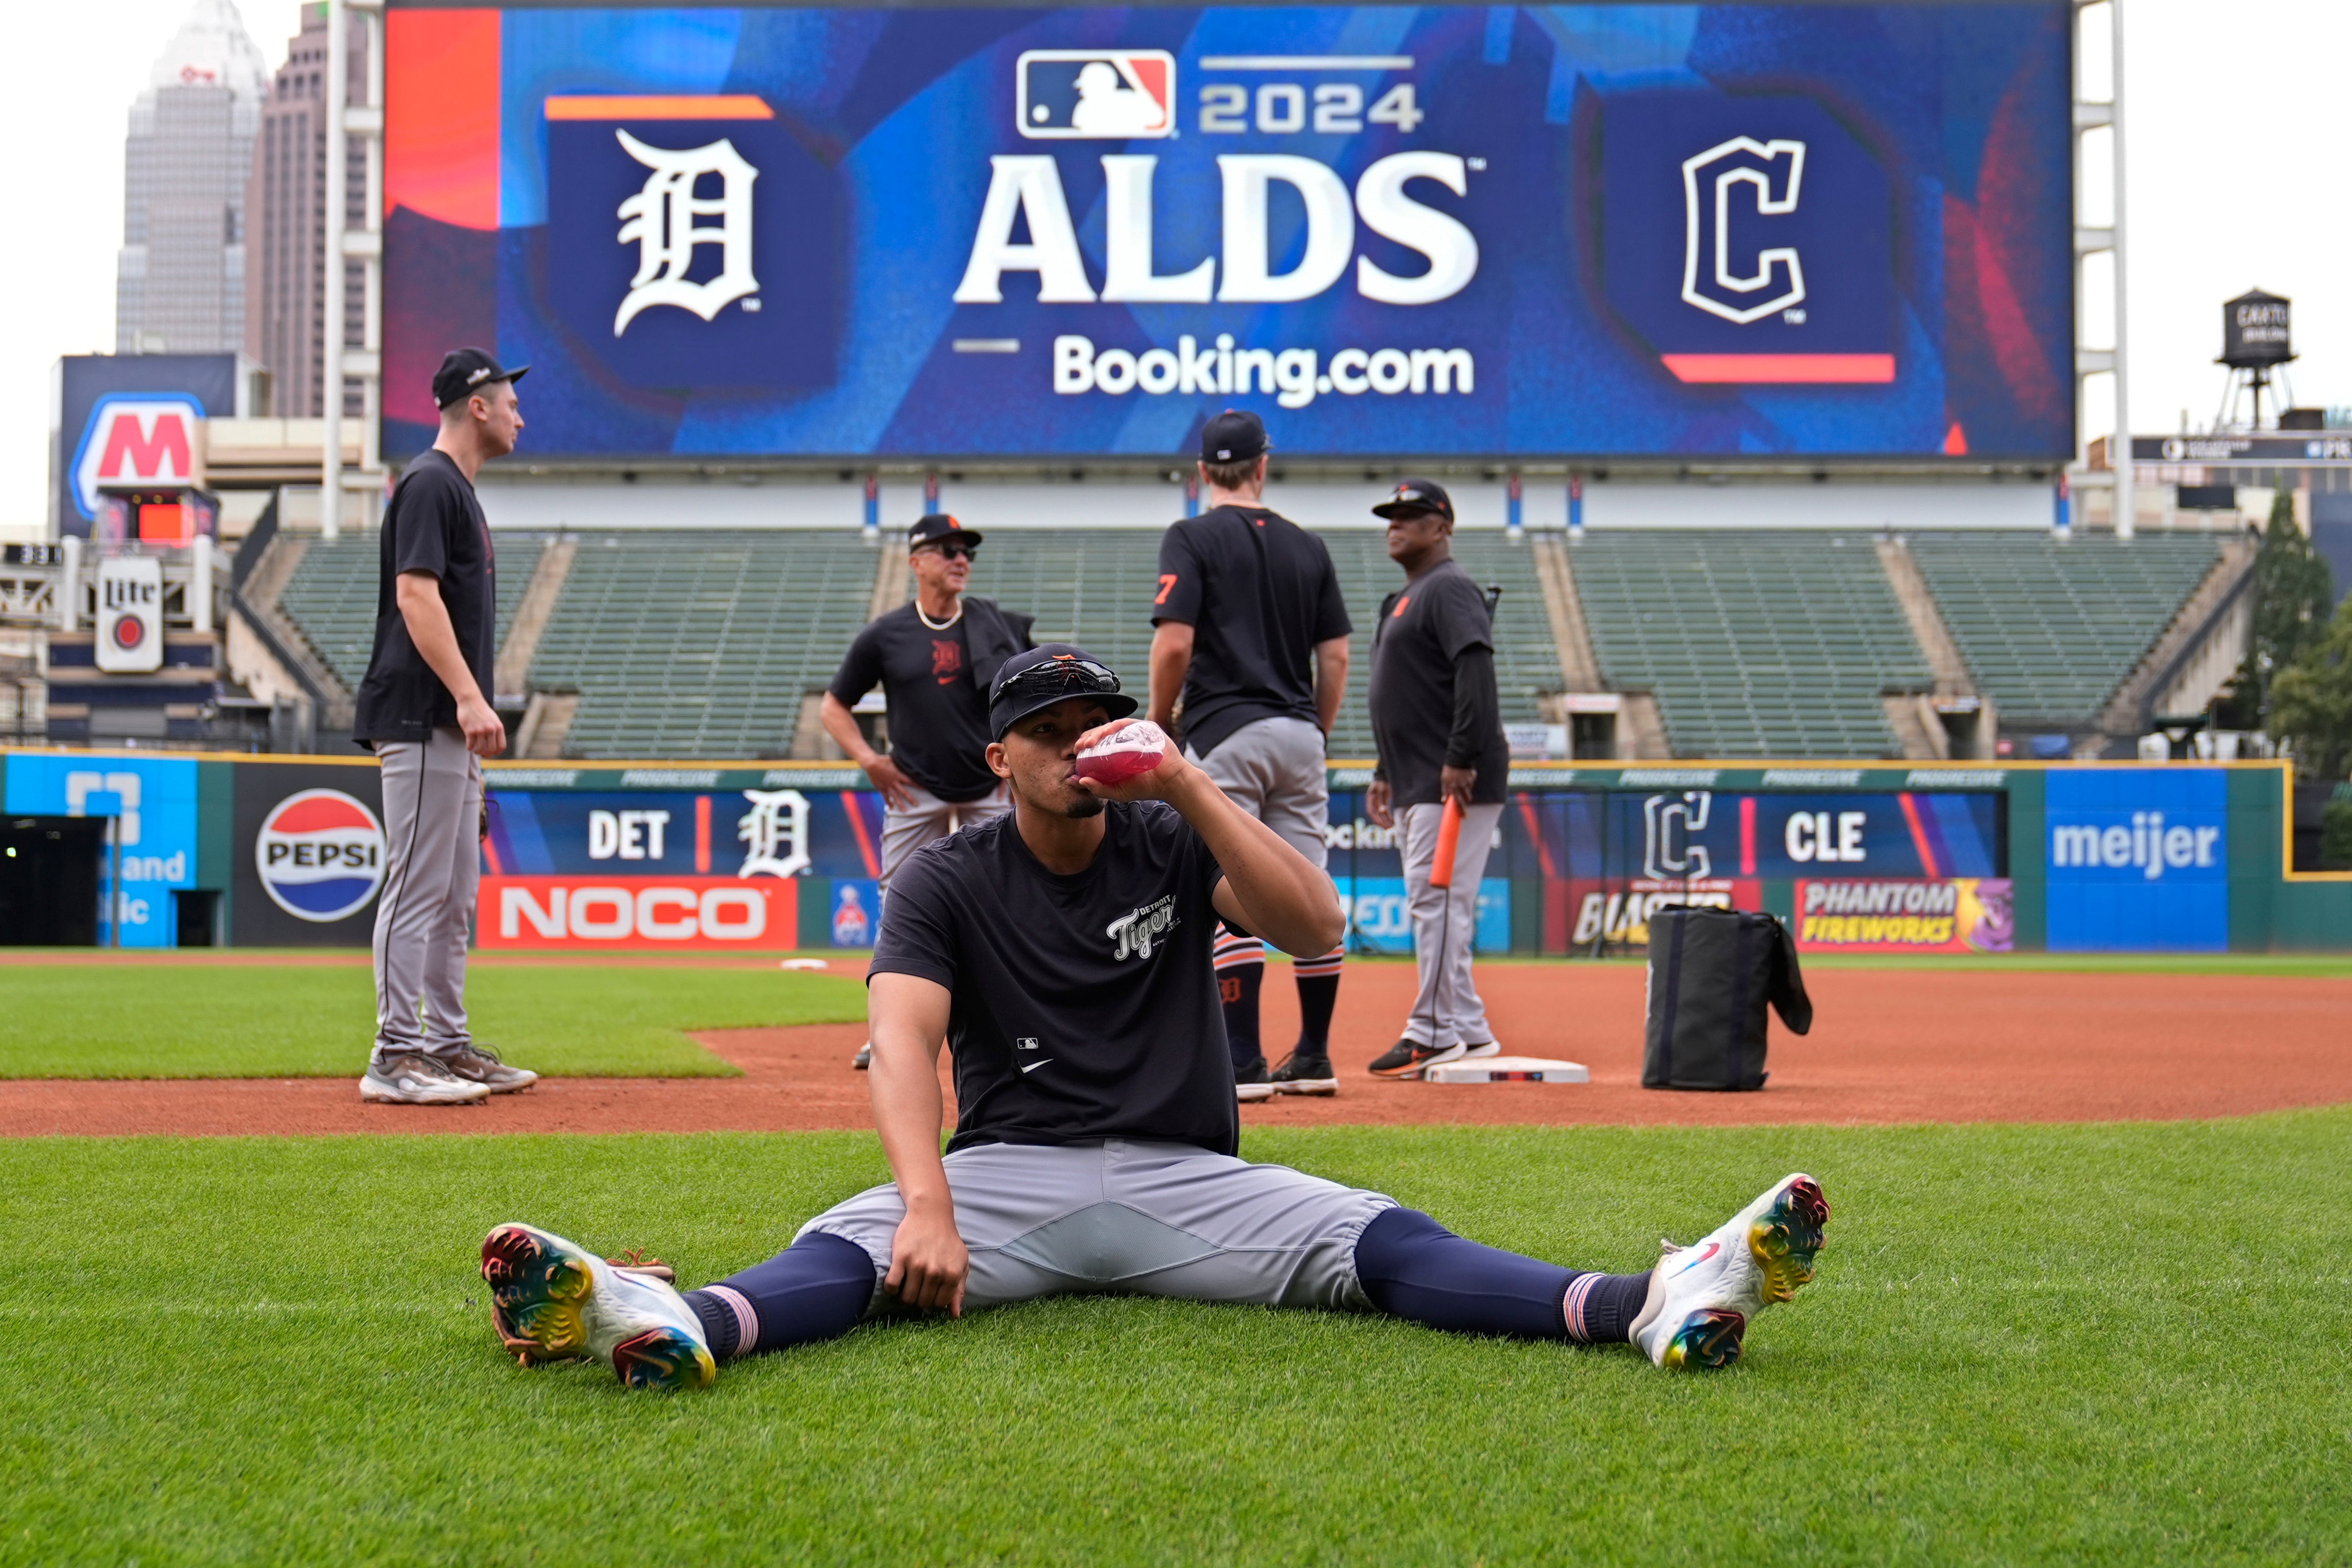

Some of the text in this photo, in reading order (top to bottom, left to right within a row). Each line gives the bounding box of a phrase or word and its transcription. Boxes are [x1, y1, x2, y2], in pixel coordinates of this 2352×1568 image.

[1199, 84, 1423, 133] 2024
[614, 127, 761, 338] D
[952, 151, 1480, 305] ALDS
[1681, 135, 1806, 324] C
[1053, 332, 1474, 409] Booking.com
[98, 414, 190, 478] M
[106, 577, 155, 611] Lite
[1154, 574, 1178, 605] 7
[268, 842, 377, 867] PEPSI
[589, 810, 670, 860] DET
[1785, 812, 1867, 862] CLE
[2053, 811, 2219, 879] meijer
[500, 887, 766, 940] NOCO
[1139, 894, 1171, 915] DETROIT
[1804, 882, 1956, 914] PHANTOM
[1802, 915, 1954, 944] FIREWORKS
